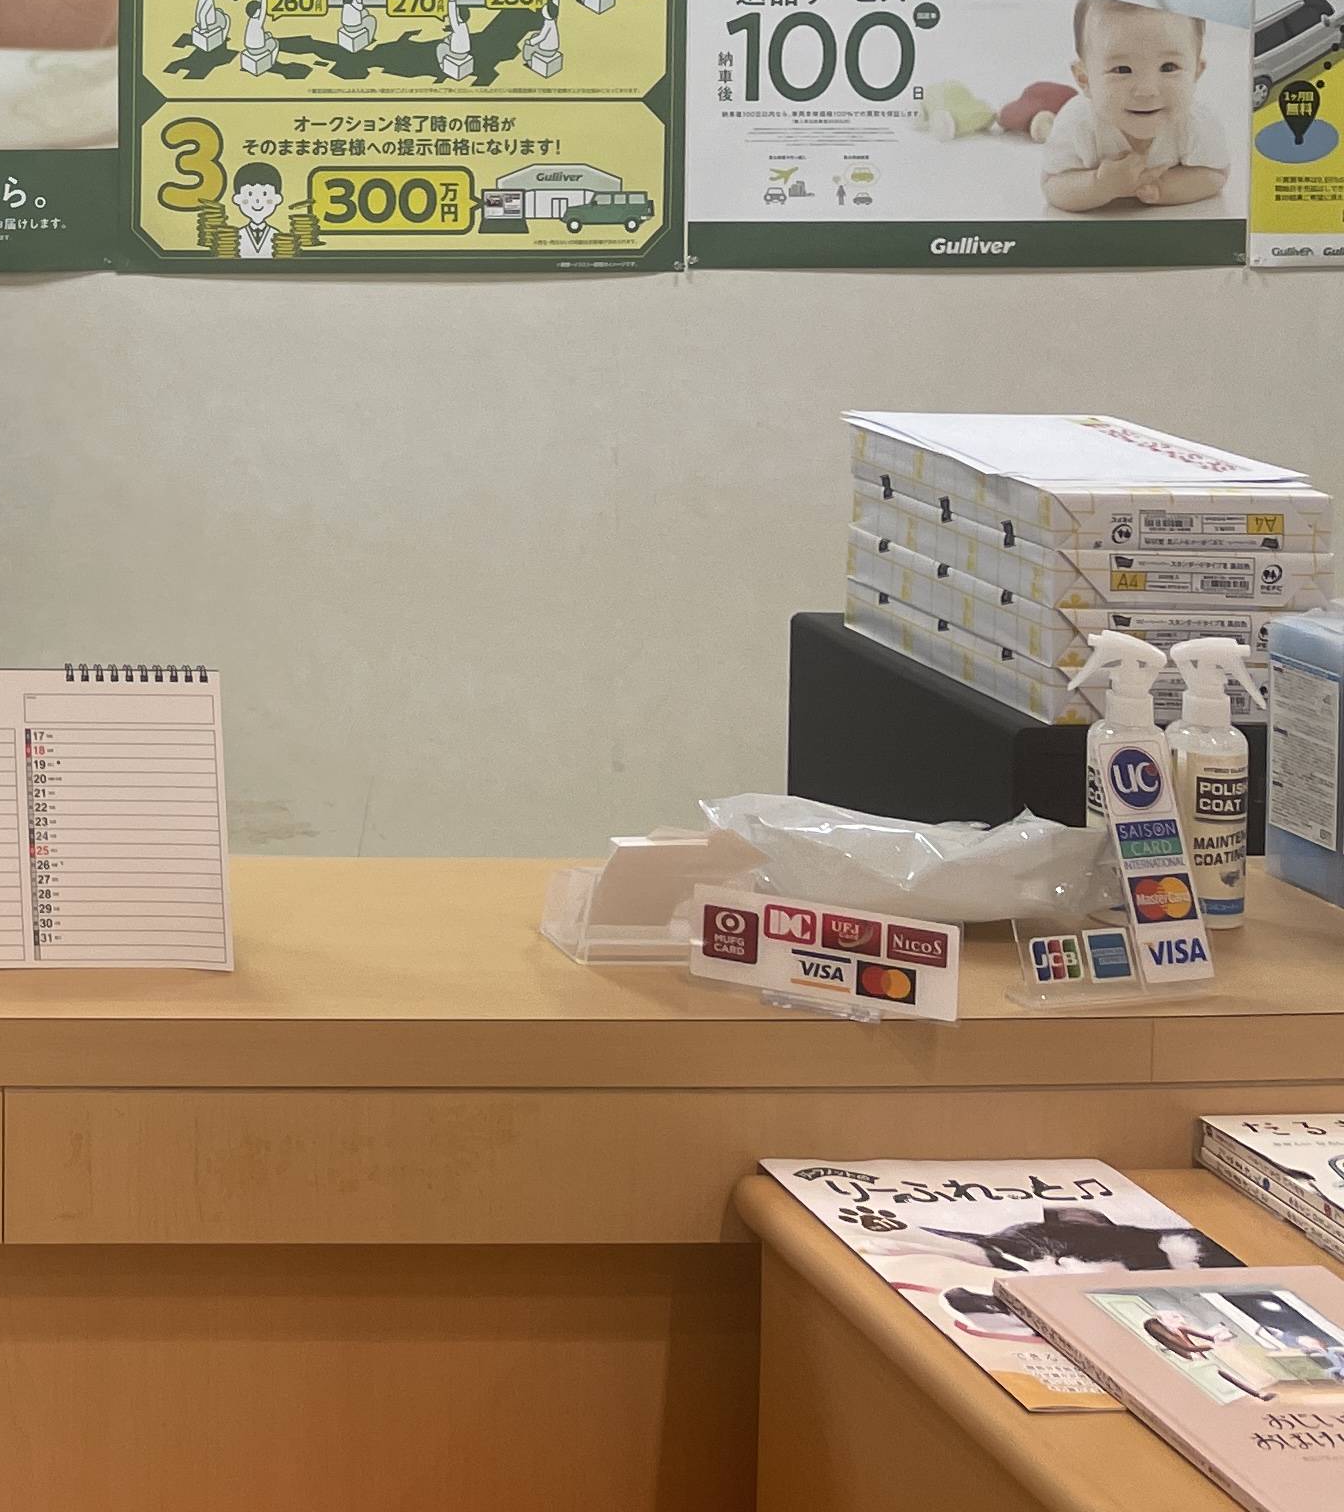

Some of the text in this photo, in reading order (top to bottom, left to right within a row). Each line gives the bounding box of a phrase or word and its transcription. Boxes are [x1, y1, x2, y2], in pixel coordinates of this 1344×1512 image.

[717, 10, 924, 102] 納車後 100 日
[293, 115, 516, 133] オークション終了時の価格が
[242, 138, 562, 156] そのままお客様への提示価格になります!
[158, 117, 227, 211] 3
[536, 171, 584, 182] Gulliver
[930, 235, 1017, 255] Gulliver
[1255, 516, 1277, 532] A4
[1116, 573, 1138, 589] A4
[33, 732, 44, 741] 17
[33, 746, 45, 755] 18
[34, 760, 46, 769] 19
[34, 774, 46, 783] 20
[1112, 761, 1159, 795] UC
[1199, 798, 1242, 813] COAT
[1119, 823, 1177, 840] SAISON
[1130, 839, 1173, 856] CARD
[1123, 857, 1185, 870] INTERNATIONAL
[769, 909, 812, 940] DC
[831, 920, 860, 934] UFJ
[713, 933, 745, 947] MUFG
[713, 942, 745, 956] CARD
[1147, 938, 1208, 966] VISA
[1033, 950, 1078, 969] JCB
[798, 959, 844, 982] VISA
